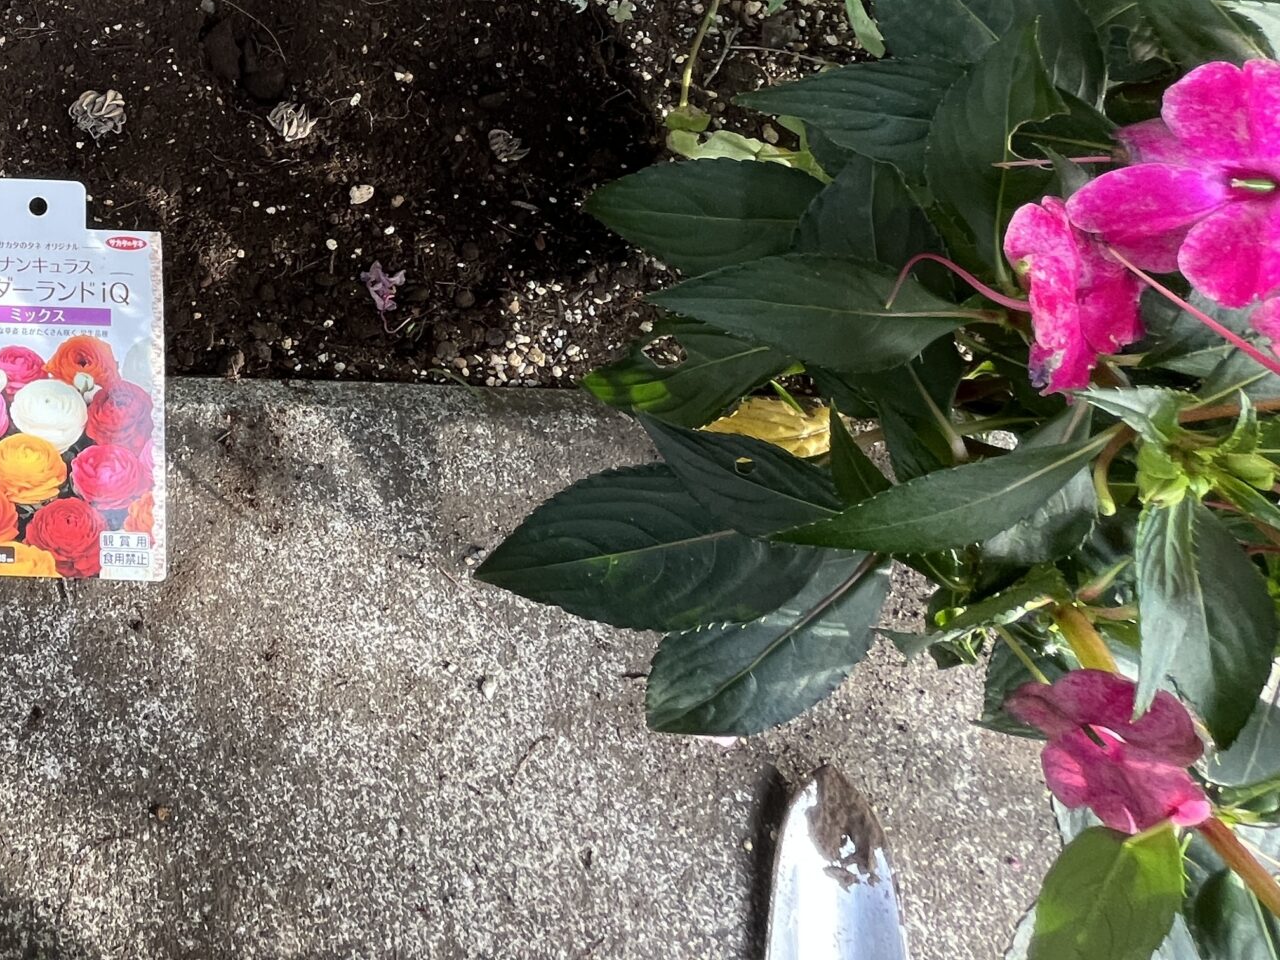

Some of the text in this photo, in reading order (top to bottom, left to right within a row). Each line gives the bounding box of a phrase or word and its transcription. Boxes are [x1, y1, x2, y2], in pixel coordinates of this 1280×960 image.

[45, 242, 79, 251] オリジナル
[108, 239, 144, 249] サカタのタネ
[10, 308, 65, 323] ミックス
[103, 553, 148, 567] 食用禁止
